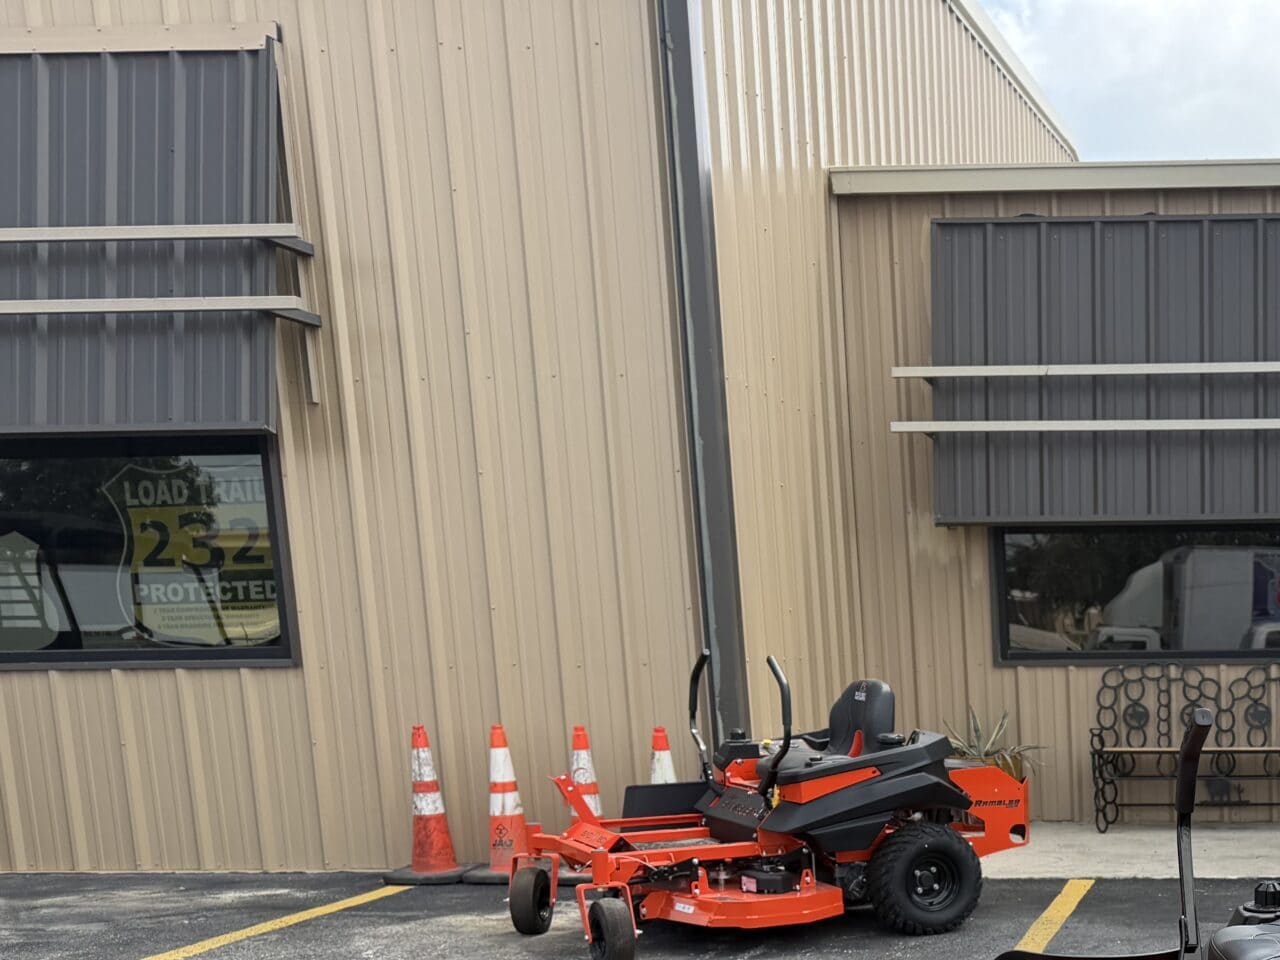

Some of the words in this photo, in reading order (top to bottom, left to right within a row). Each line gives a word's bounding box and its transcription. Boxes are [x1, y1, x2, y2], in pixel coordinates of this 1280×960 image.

[123, 480, 188, 505] LOAD
[195, 479, 265, 504] TRAIL
[134, 579, 277, 603] PROTECTED
